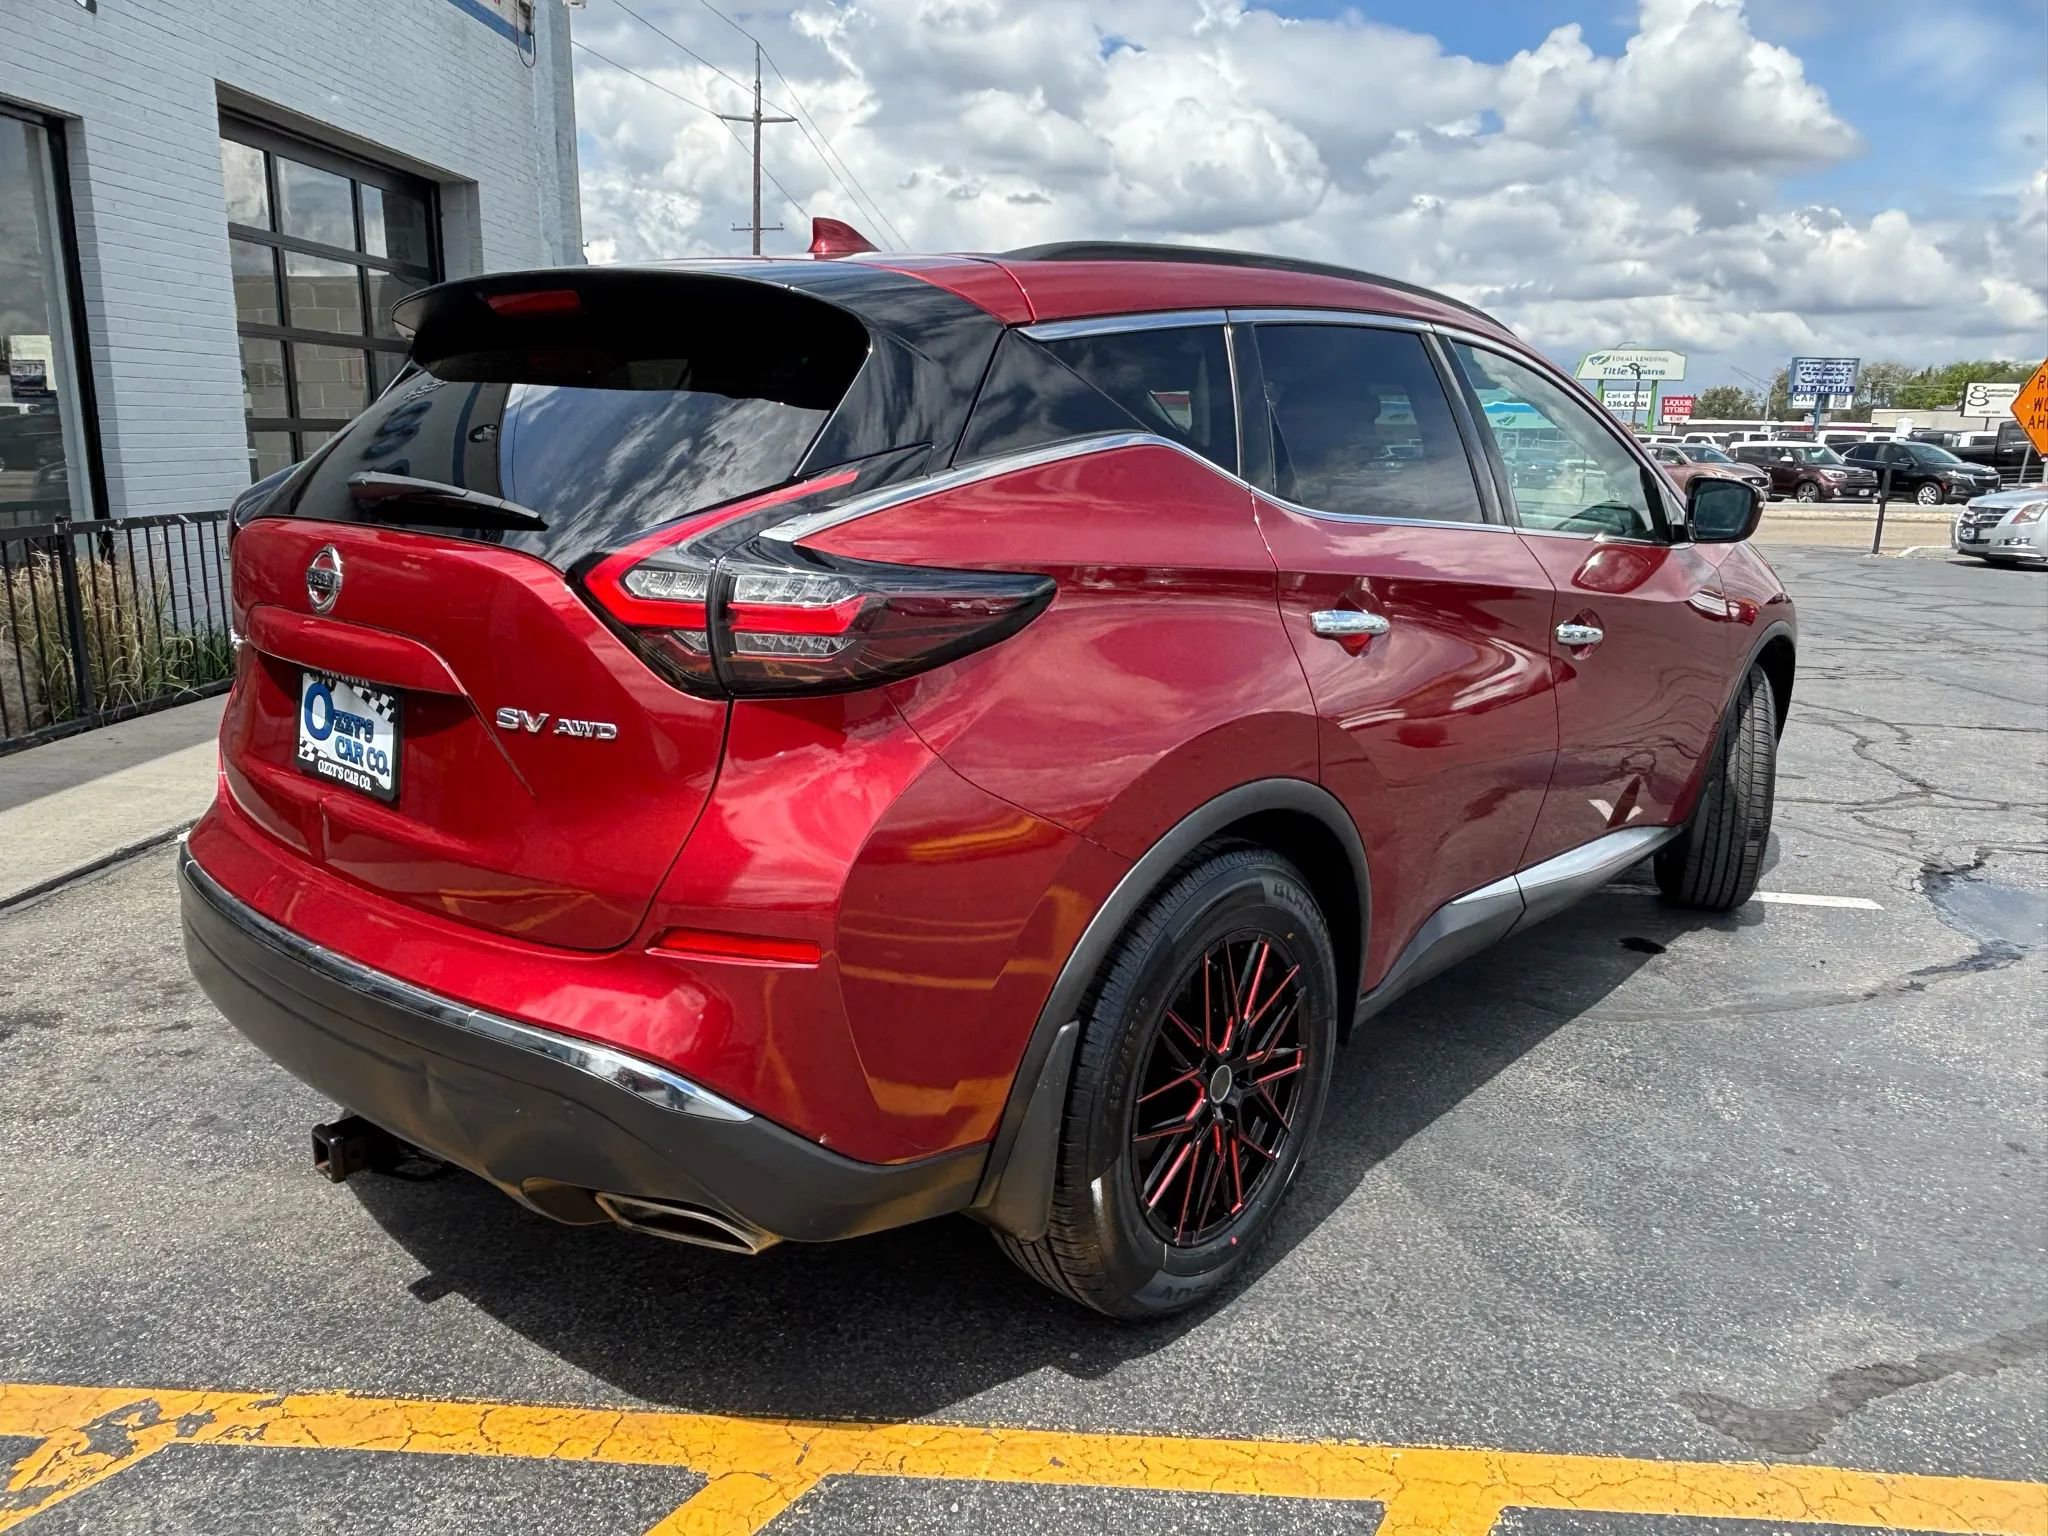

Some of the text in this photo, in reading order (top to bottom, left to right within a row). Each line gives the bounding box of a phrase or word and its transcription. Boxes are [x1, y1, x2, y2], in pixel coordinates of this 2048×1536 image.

[1664, 399, 1693, 407] LIQUOR
[496, 707, 618, 740] SV AWD
[335, 735, 364, 767] CAR
[344, 768, 360, 787] CAR
